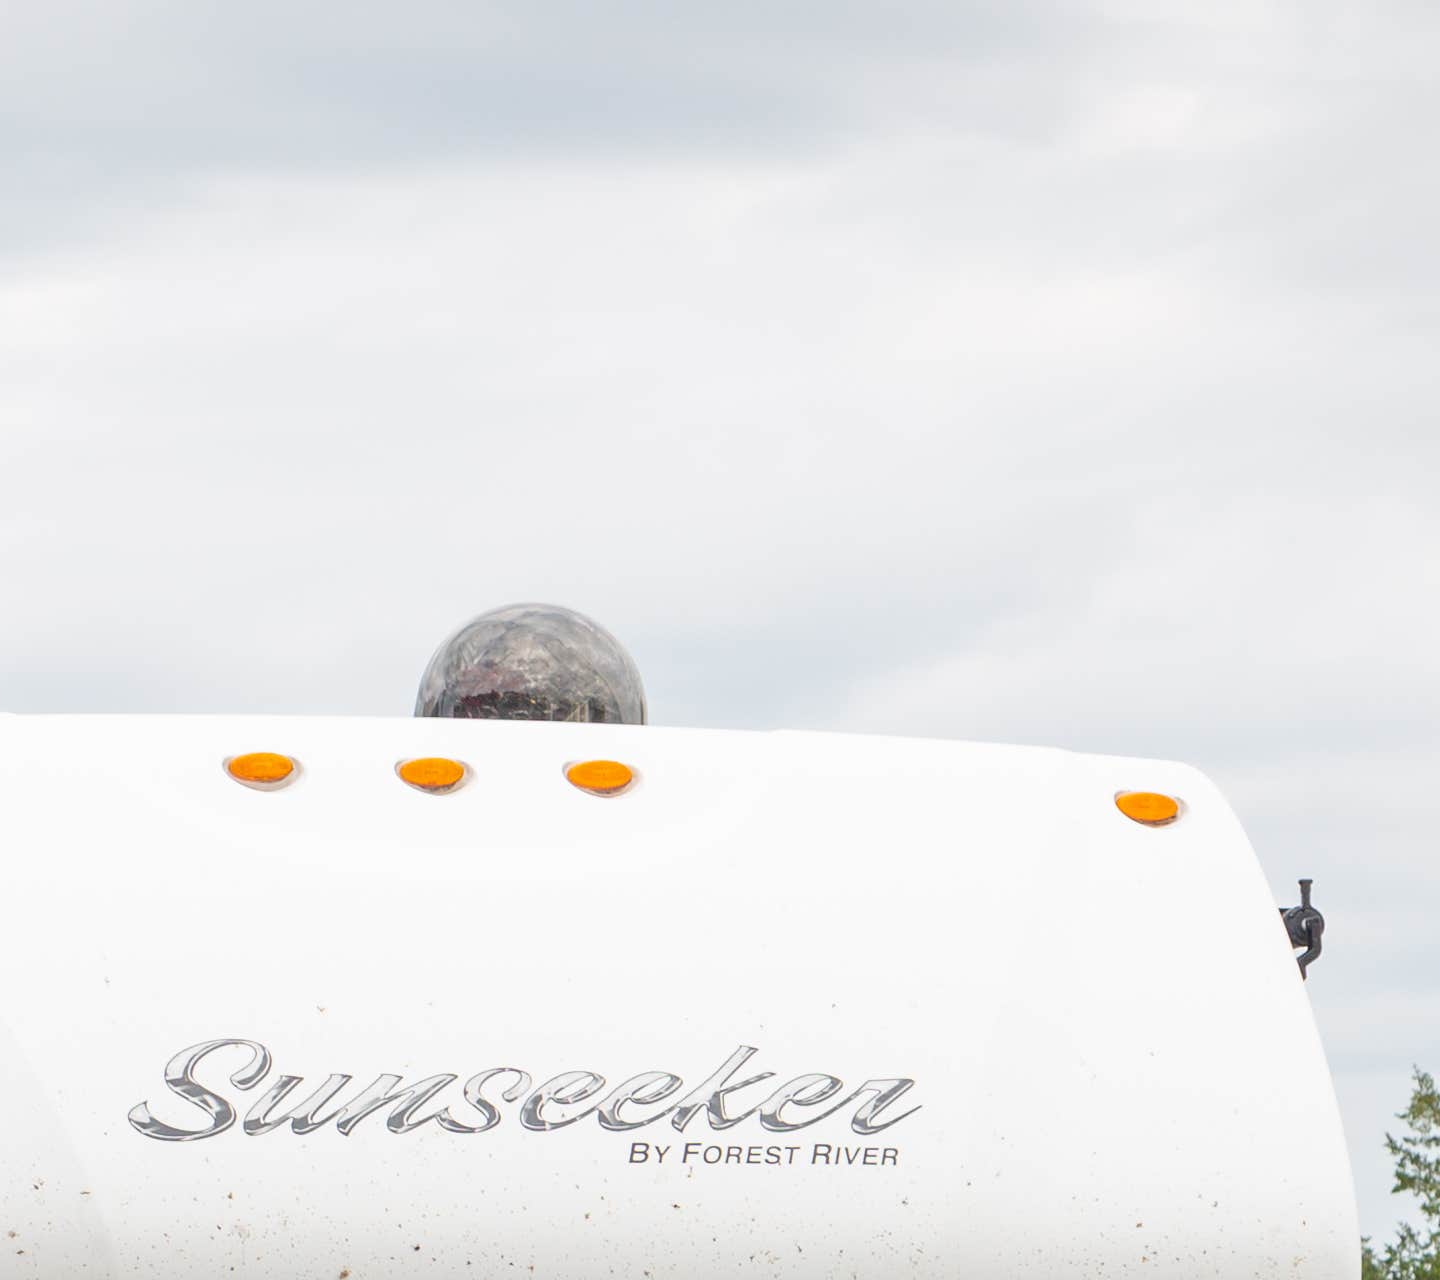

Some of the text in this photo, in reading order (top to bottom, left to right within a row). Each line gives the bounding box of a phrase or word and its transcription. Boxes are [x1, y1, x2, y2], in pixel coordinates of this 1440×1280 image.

[128, 1038, 922, 1140] Sunseeker
[628, 1143, 900, 1166] BY FOREST RIVER
